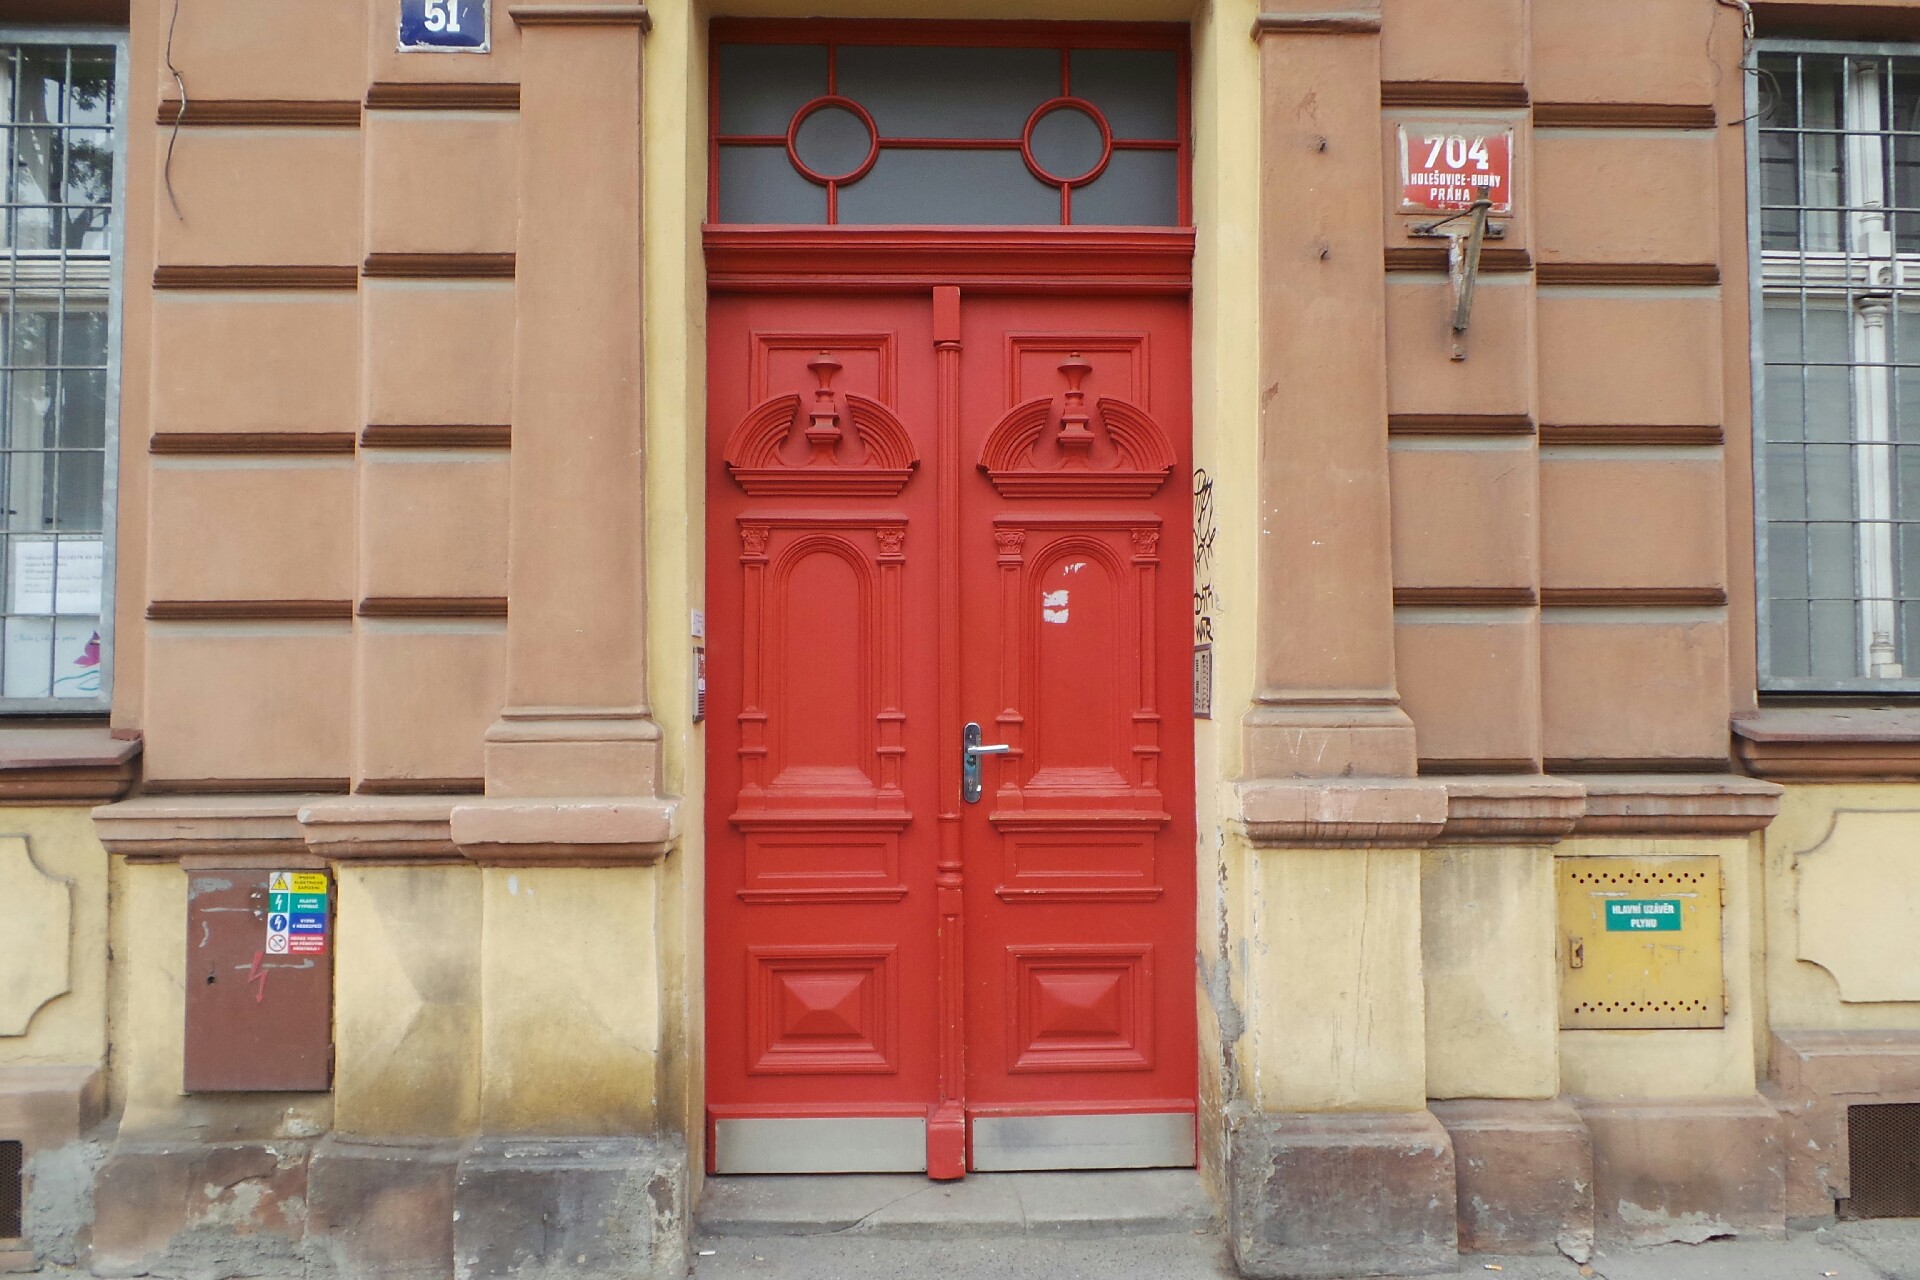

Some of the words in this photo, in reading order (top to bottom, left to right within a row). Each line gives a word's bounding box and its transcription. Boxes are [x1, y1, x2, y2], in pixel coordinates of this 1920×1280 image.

[424, 0, 460, 32] 51
[1423, 134, 1489, 170] 704
[1612, 903, 1642, 914] HLAVNÍ
[1630, 918, 1658, 928] PLYNU
